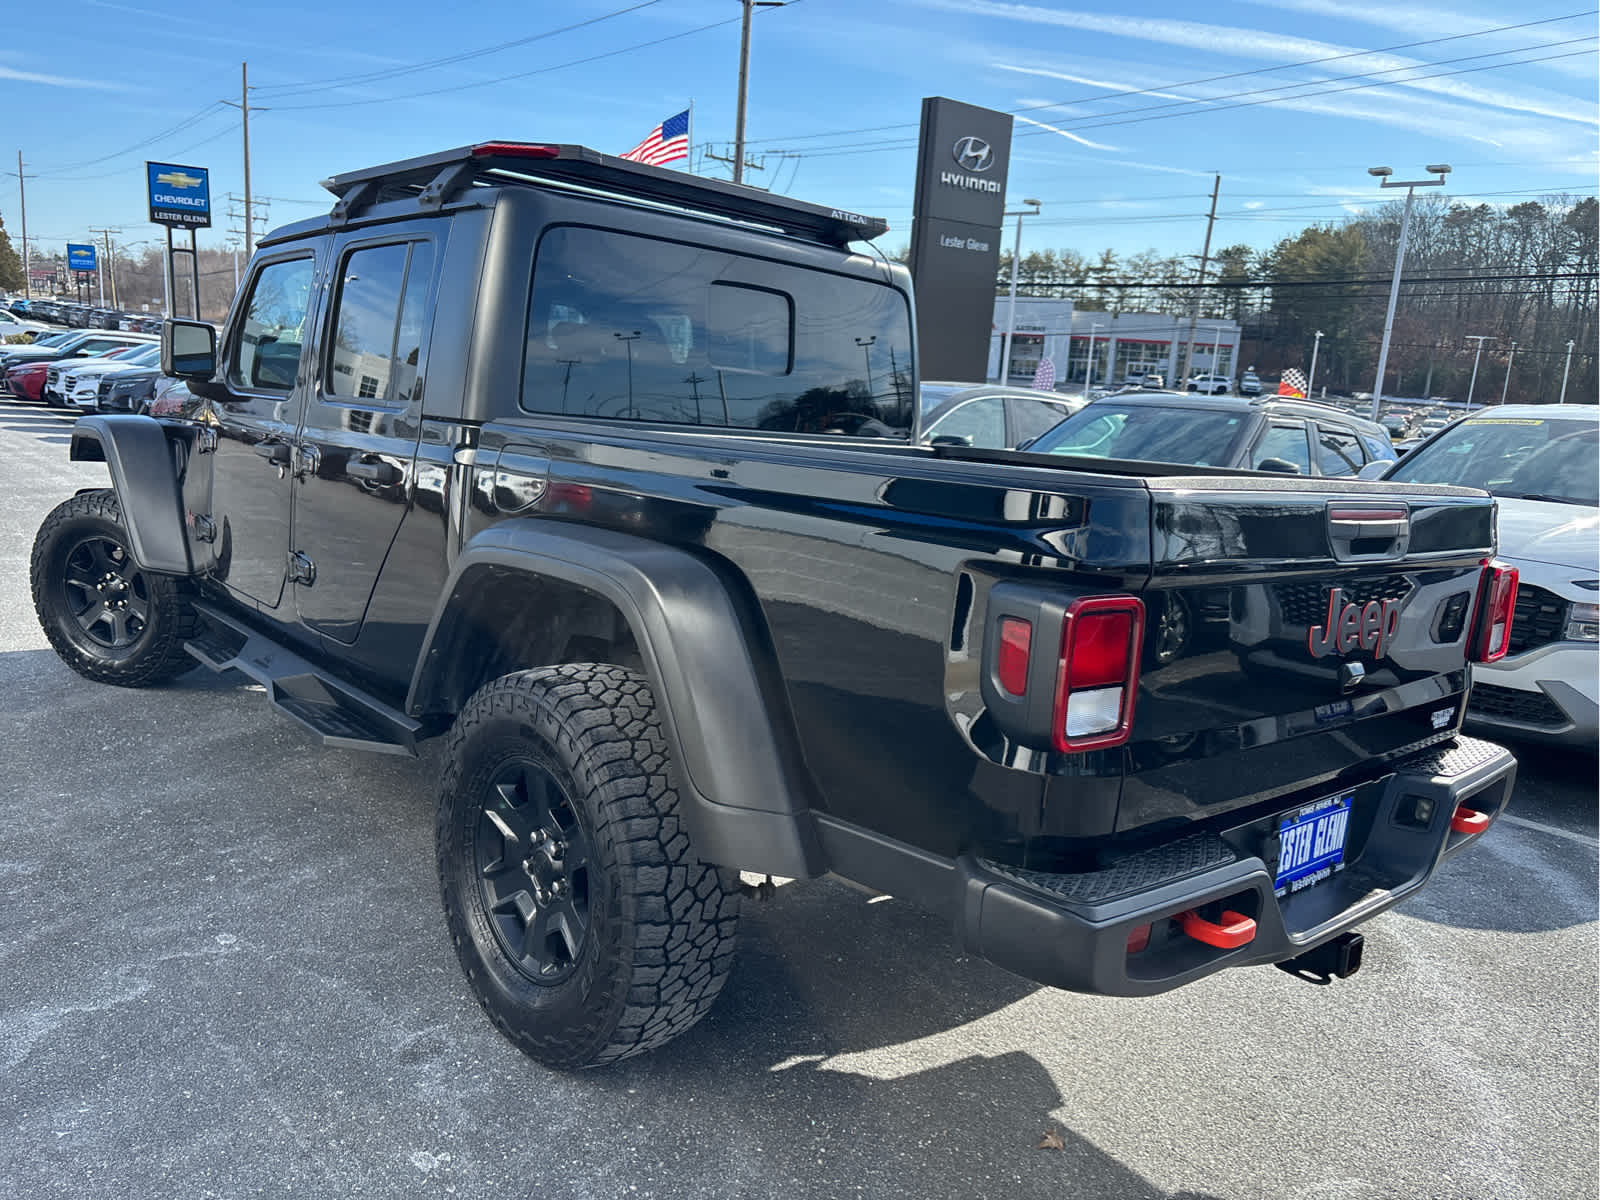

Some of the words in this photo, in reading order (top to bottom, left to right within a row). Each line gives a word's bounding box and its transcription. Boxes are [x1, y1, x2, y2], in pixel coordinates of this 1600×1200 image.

[941, 171, 1000, 193] HYUNDAI
[154, 194, 206, 207] CHEVROLET
[154, 212, 182, 221] LESTER
[183, 214, 208, 223] GLENN
[832, 210, 867, 225] ATTICA
[940, 233, 966, 249] Lester
[966, 238, 990, 252] Glenn
[1308, 588, 1401, 660] Jeep
[1313, 810, 1349, 859] GLENN
